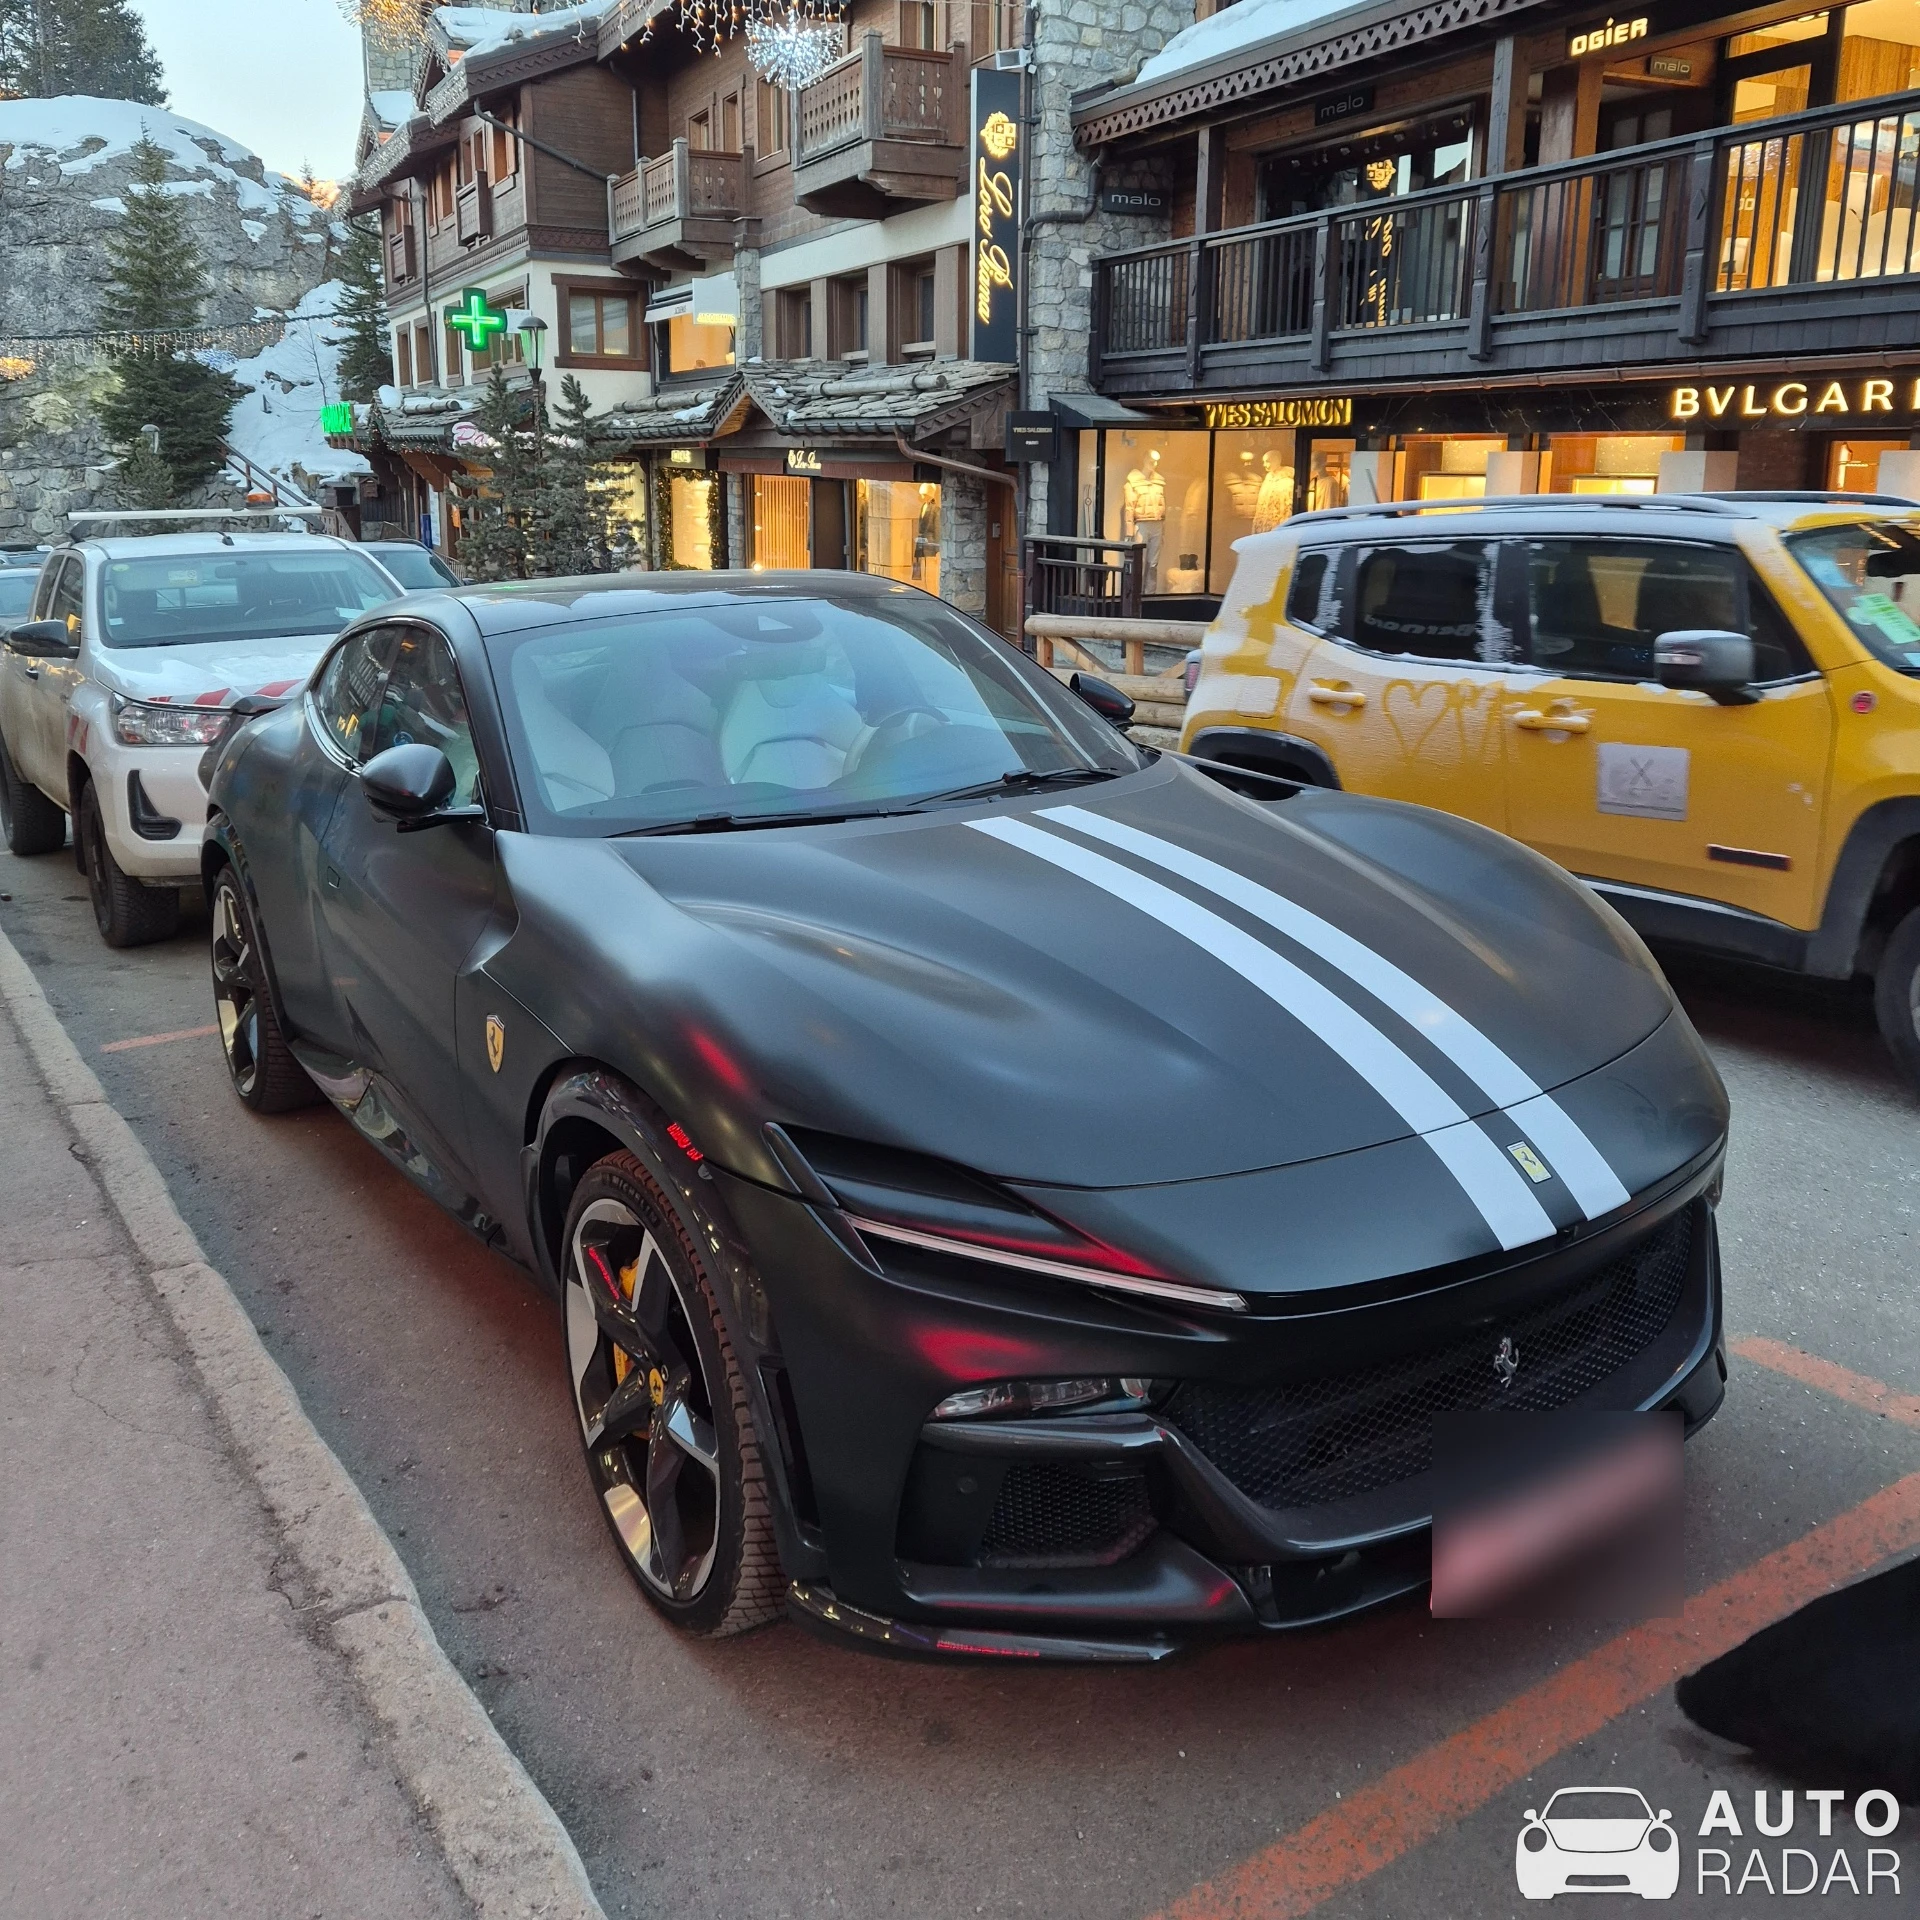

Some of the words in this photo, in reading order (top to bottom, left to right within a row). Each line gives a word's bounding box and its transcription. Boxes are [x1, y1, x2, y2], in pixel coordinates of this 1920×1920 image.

[1653, 60, 1690, 73] malo
[1320, 94, 1364, 119] malo
[979, 156, 1013, 238] Loro
[1111, 192, 1161, 206] malo
[979, 238, 1014, 324] Piana
[1205, 402, 1250, 428] YVES
[1251, 398, 1352, 427] SALOMON
